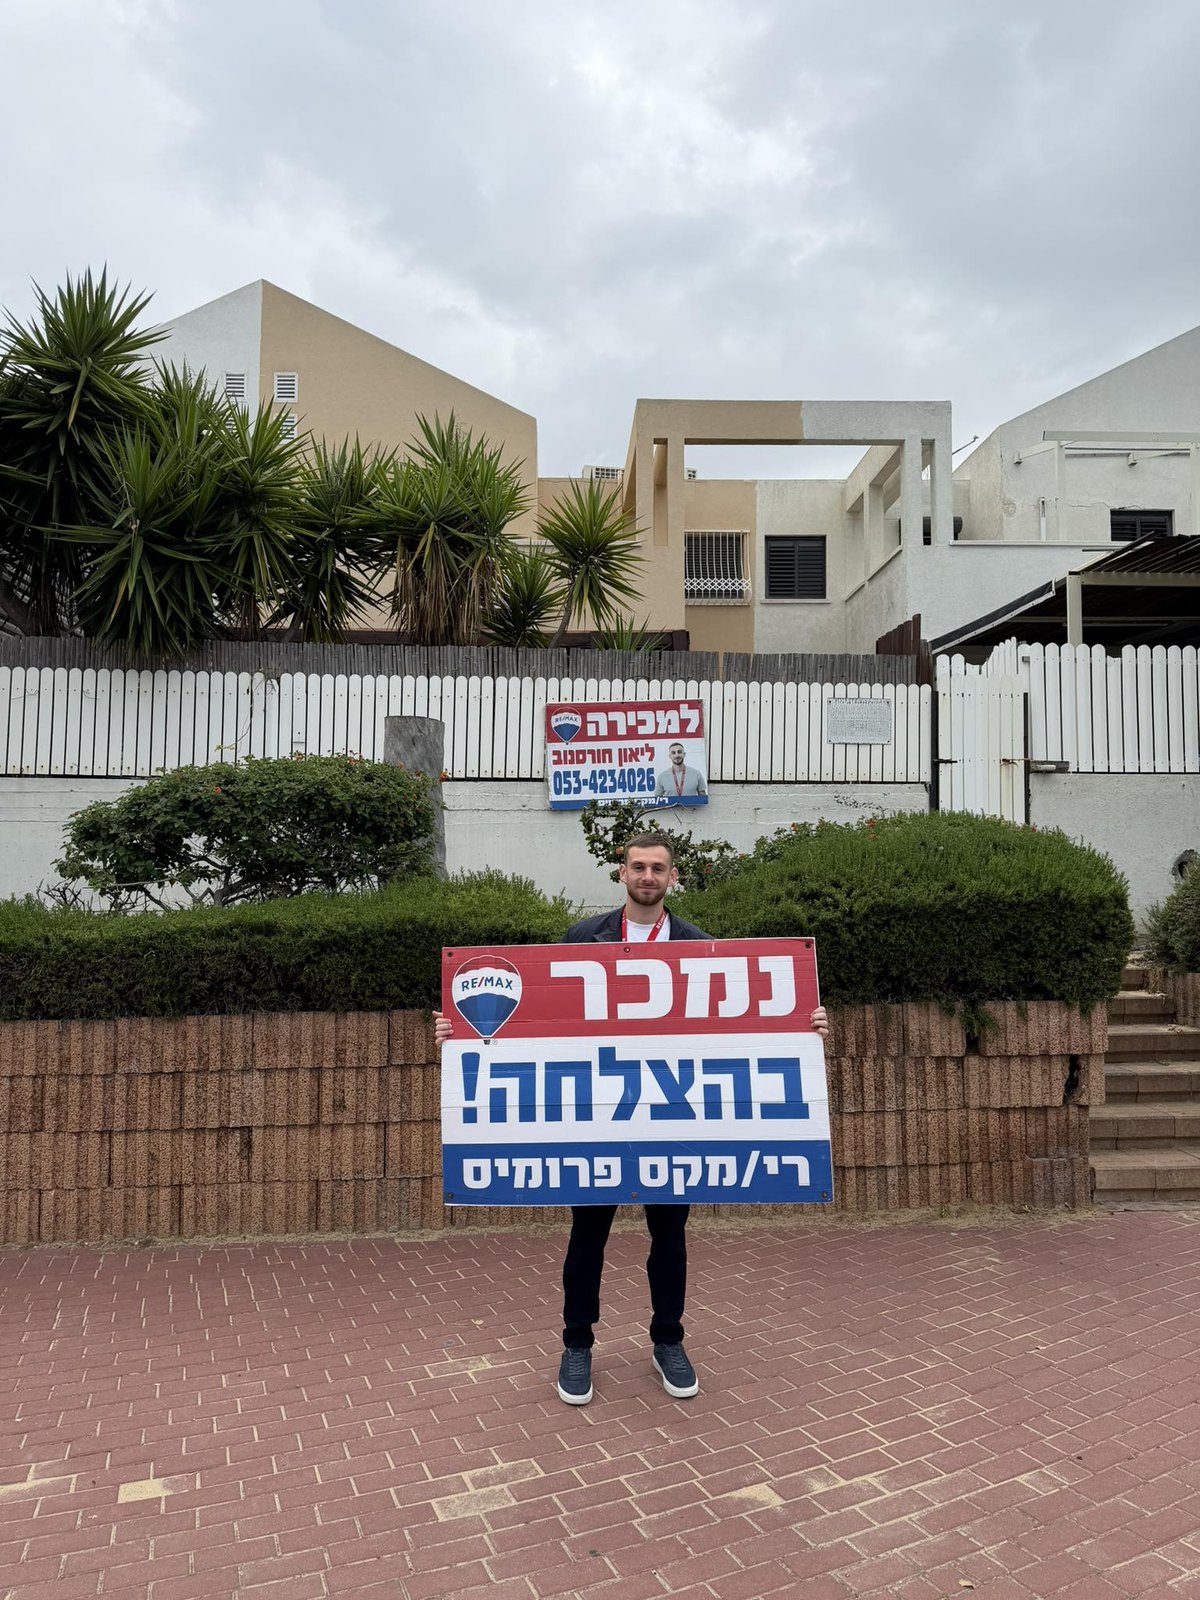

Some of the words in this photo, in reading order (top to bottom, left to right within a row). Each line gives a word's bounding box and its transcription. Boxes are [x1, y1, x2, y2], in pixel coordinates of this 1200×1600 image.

[554, 715, 578, 723] RE/MAX
[586, 703, 700, 737] למכירה
[552, 748, 613, 766] חורסנוב
[618, 743, 655, 767] ליאון
[553, 767, 656, 796] 053-4234026
[461, 976, 513, 992] RE/MAX
[550, 955, 796, 1020] נמכר
[461, 1046, 810, 1124] בהצלחה!
[462, 1155, 622, 1189] פרומיס
[639, 1150, 811, 1196] רי/מקס
